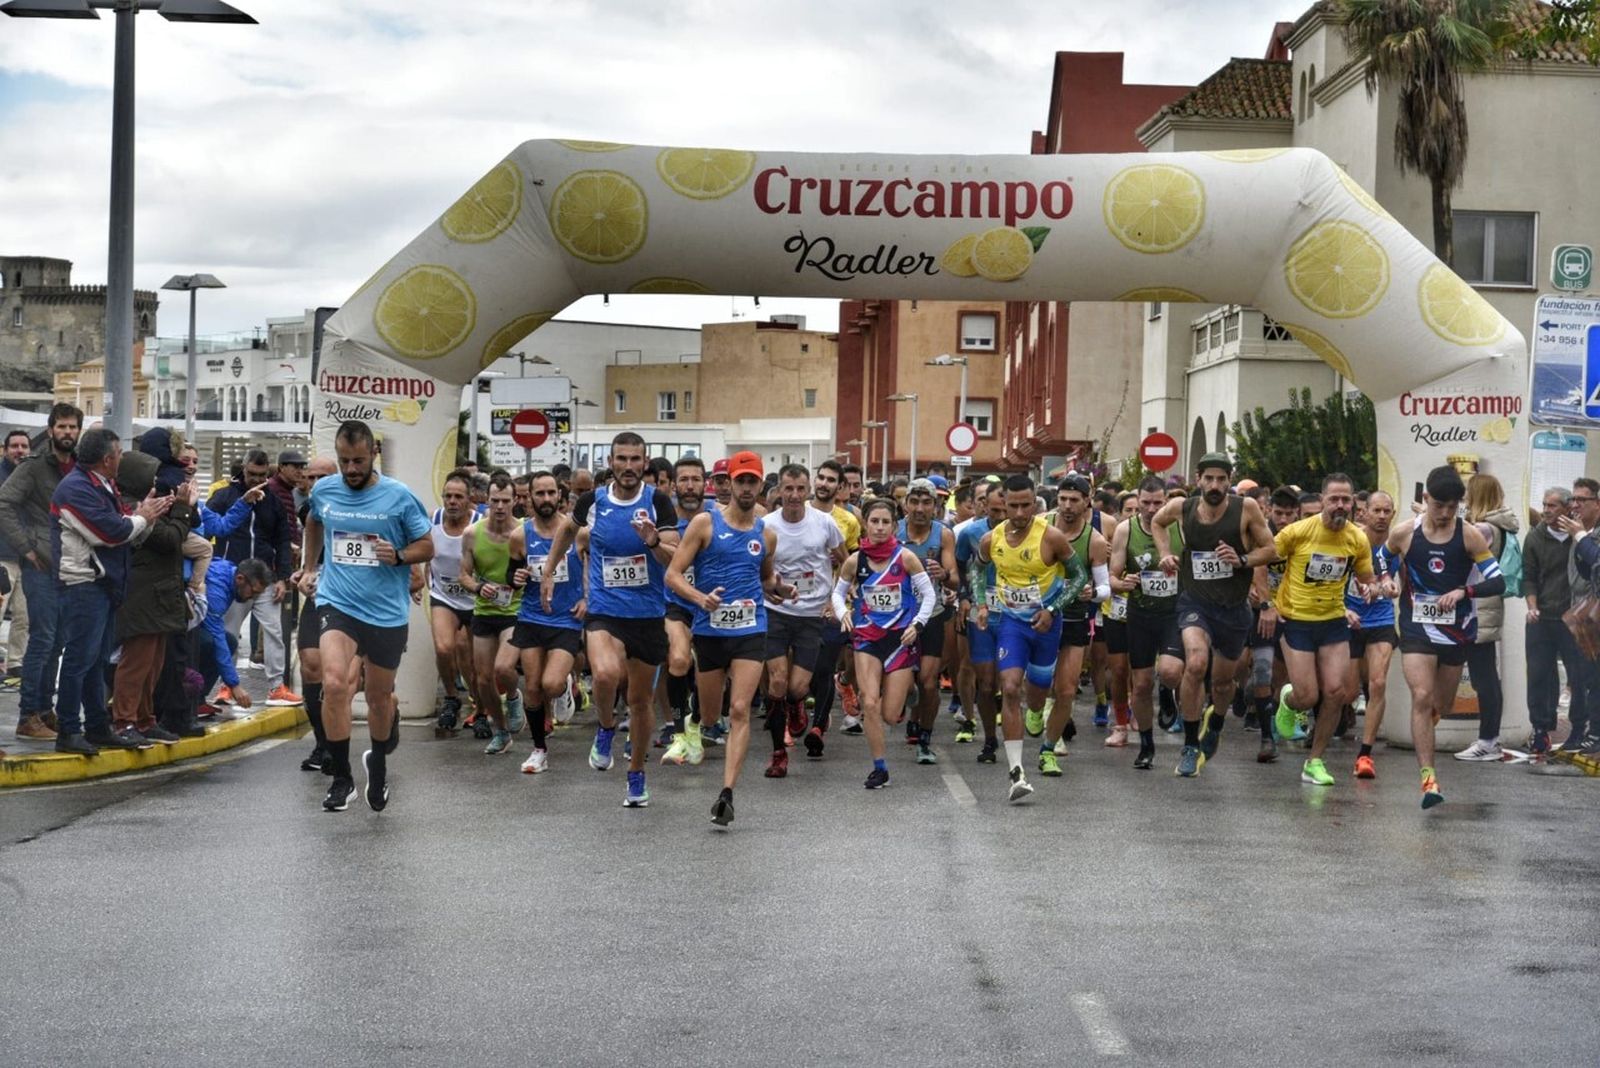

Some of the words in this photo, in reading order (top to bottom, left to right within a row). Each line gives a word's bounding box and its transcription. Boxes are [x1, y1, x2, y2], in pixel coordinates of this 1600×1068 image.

[753, 165, 1074, 226] Cruzcampo
[783, 229, 940, 281] Radler
[1563, 280, 1583, 289] BUS
[1539, 299, 1591, 311] fundación
[319, 368, 435, 399] Cruzcampo
[1399, 391, 1522, 417] Cruzcampo
[325, 399, 383, 423] Radler
[1410, 422, 1478, 447] Radler
[346, 542, 362, 556] 88
[613, 567, 636, 580] 318
[1201, 561, 1221, 574] 381
[1319, 563, 1333, 575] 89
[1149, 579, 1168, 591] 220
[872, 594, 892, 606] 152
[721, 609, 744, 622] 294
